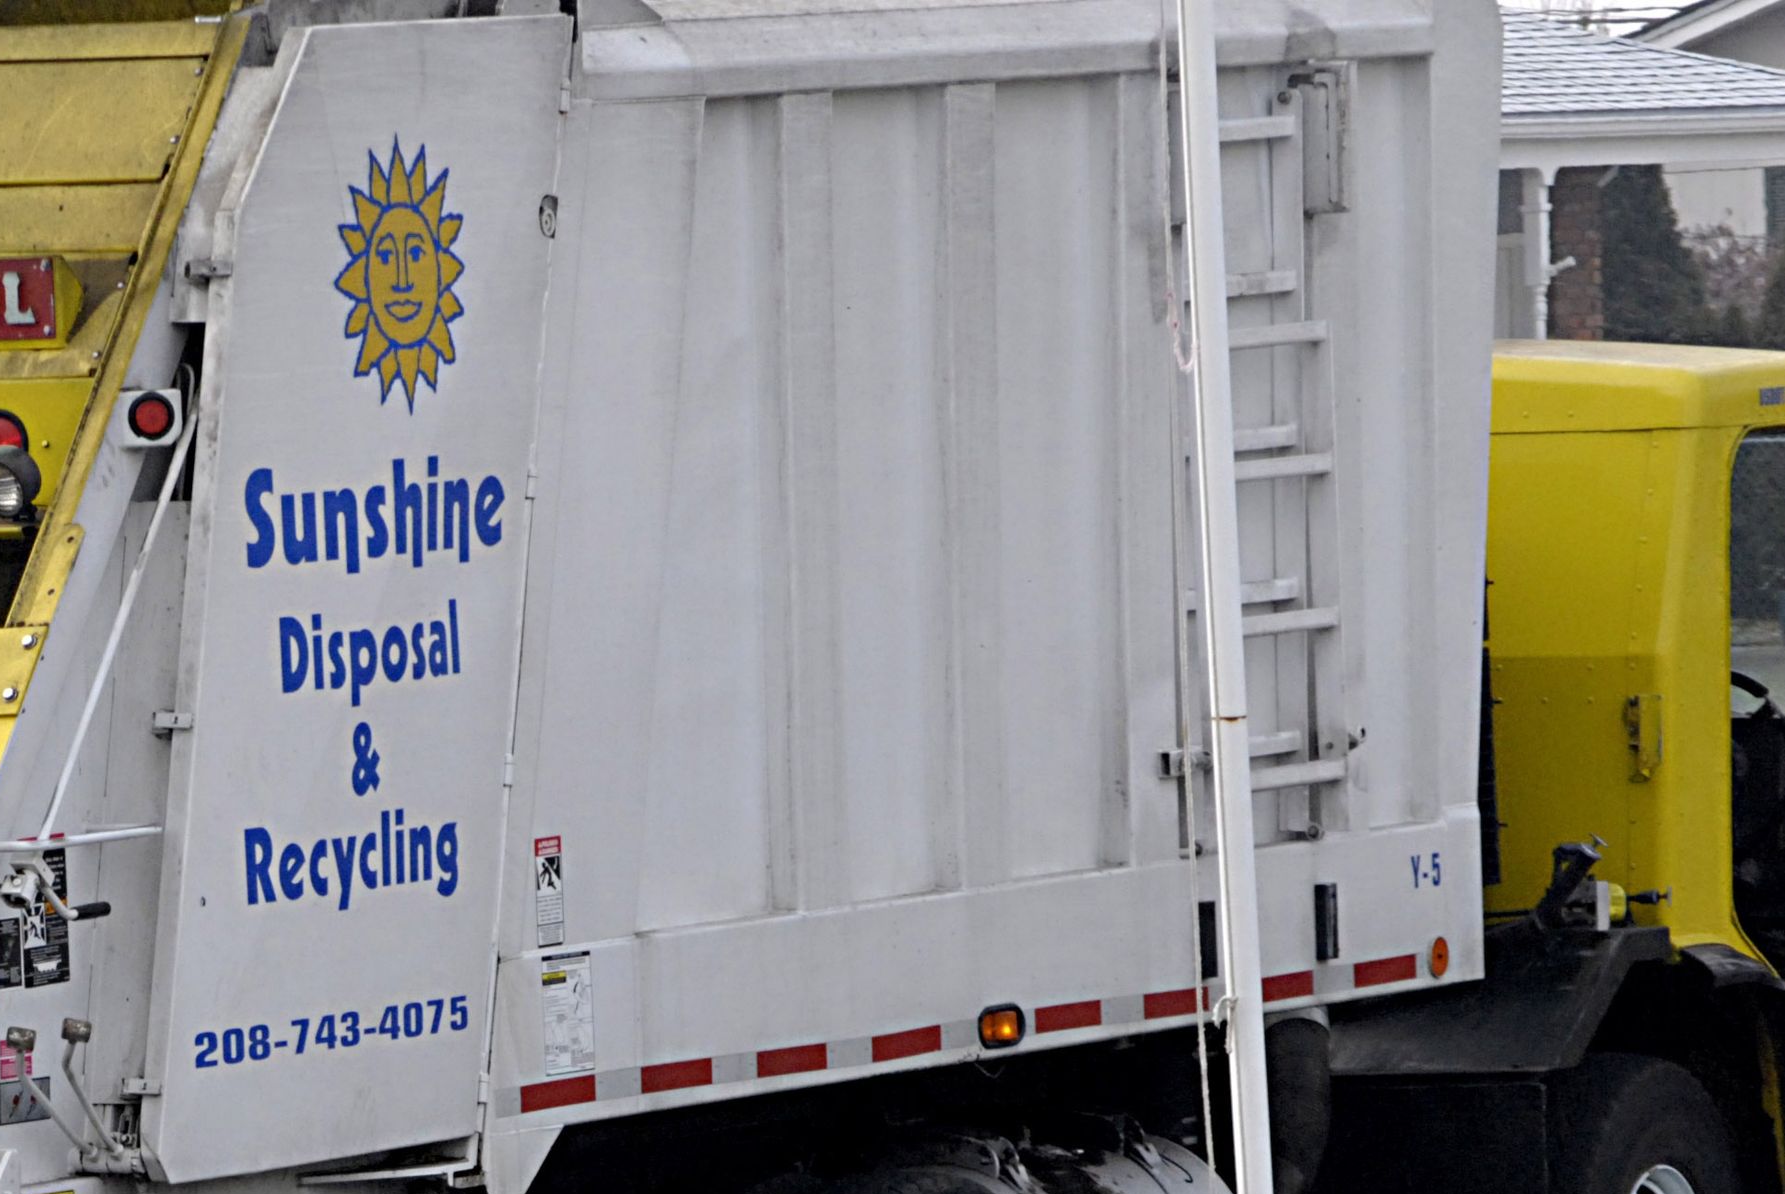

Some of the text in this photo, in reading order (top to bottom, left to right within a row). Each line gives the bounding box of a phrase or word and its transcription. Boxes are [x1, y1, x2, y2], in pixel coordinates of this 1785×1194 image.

[244, 455, 506, 574] Sunshine
[279, 599, 461, 707] Disposal
[352, 721, 381, 796] &
[244, 808, 459, 911] Recycling
[1410, 852, 1442, 889] Y-5
[194, 995, 469, 1069] 208-743-4075
